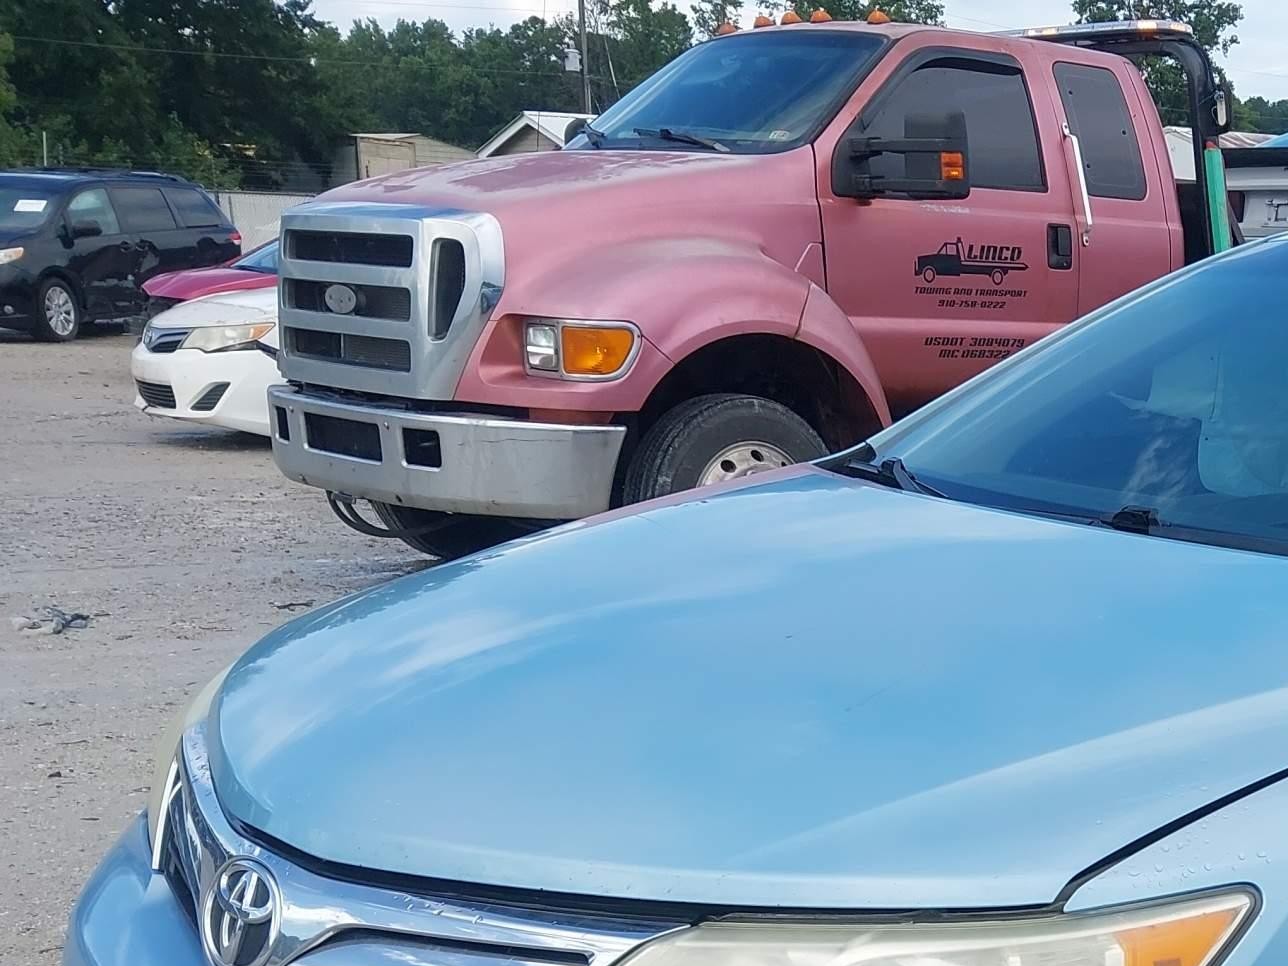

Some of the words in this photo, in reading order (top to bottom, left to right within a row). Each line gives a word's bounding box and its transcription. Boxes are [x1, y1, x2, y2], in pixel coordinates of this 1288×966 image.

[966, 244, 1022, 262] LINCO
[914, 286, 952, 295] TOWING
[953, 287, 974, 296] AND
[975, 288, 1028, 298] TRANSPORT
[924, 337, 966, 347] USDOT
[969, 337, 1025, 348] 3084079
[938, 349, 961, 359] MC
